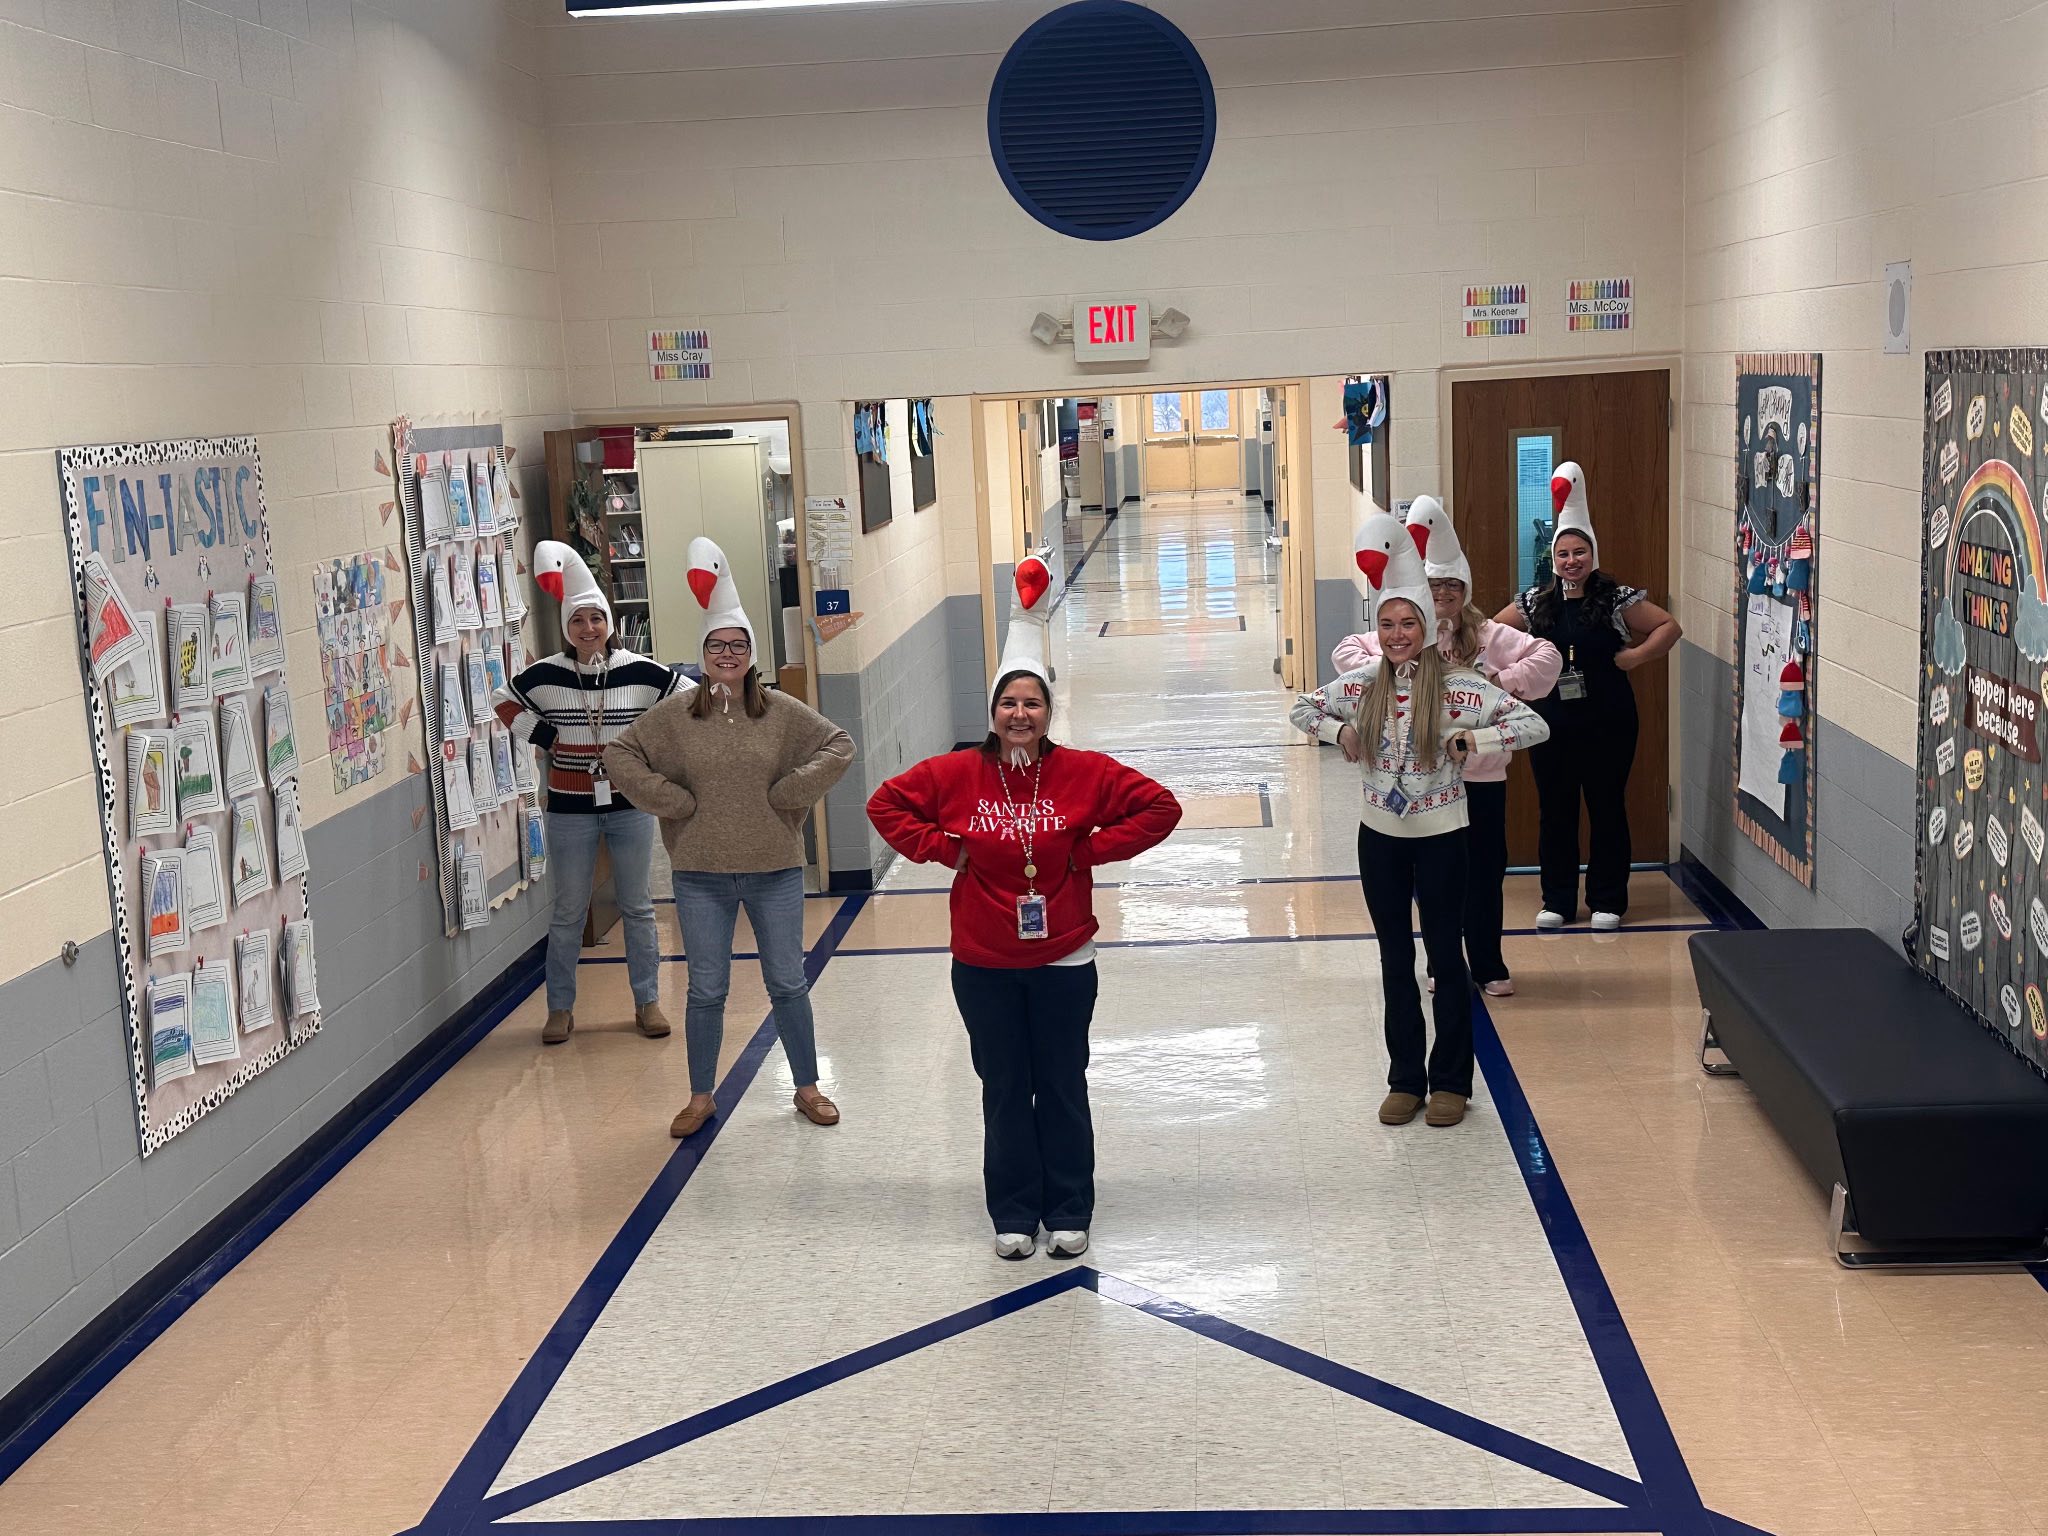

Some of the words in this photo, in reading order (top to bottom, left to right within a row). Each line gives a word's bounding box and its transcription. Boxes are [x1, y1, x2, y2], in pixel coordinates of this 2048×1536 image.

[1088, 304, 1137, 344] EXIT
[1491, 307, 1518, 316] Keener
[1569, 301, 1591, 313] Mrs.
[1593, 300, 1629, 314] McCoy
[657, 350, 679, 362] Miss
[83, 465, 257, 563] FIN-TASTIC
[1959, 542, 2012, 588] AMAZING
[826, 601, 839, 611] 37
[1964, 591, 2008, 635] THINGS
[1968, 667, 2006, 709] happen
[2008, 686, 2035, 721] here
[1976, 701, 2027, 753] because...
[977, 798, 1055, 817] SANTA'S
